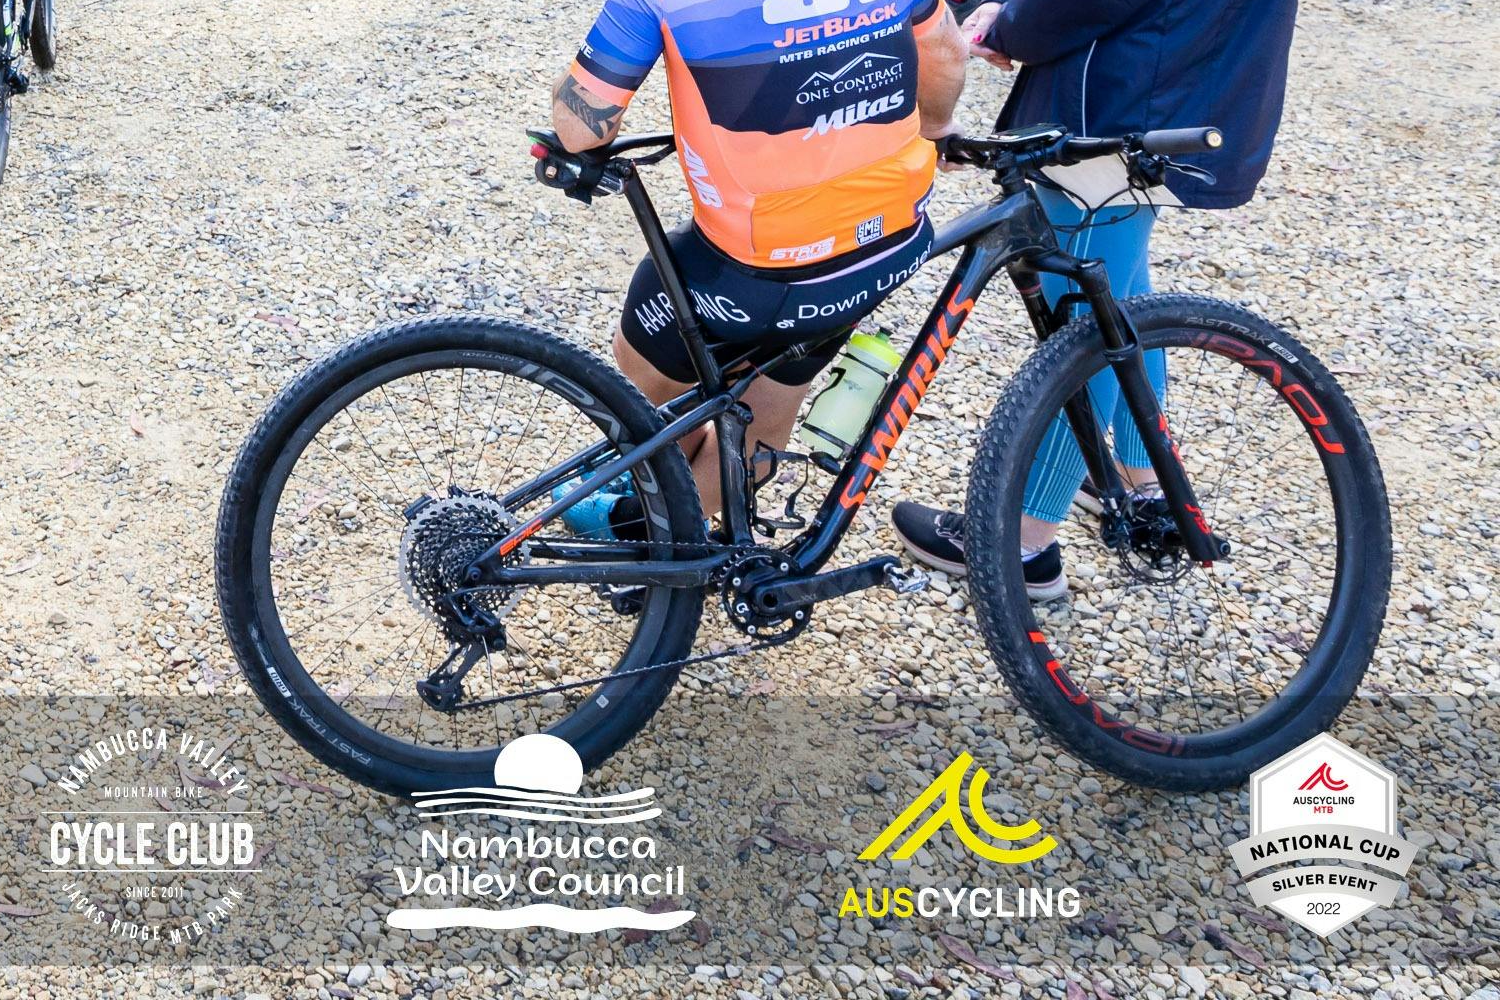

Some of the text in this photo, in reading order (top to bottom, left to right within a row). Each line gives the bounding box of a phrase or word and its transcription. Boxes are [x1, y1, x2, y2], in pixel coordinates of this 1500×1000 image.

[779, 22, 903, 64] MTB RACING TEAM
[796, 61, 904, 105] ONE CONTRACT
[802, 89, 905, 141] Mitas
[798, 242, 932, 320] Down Under
